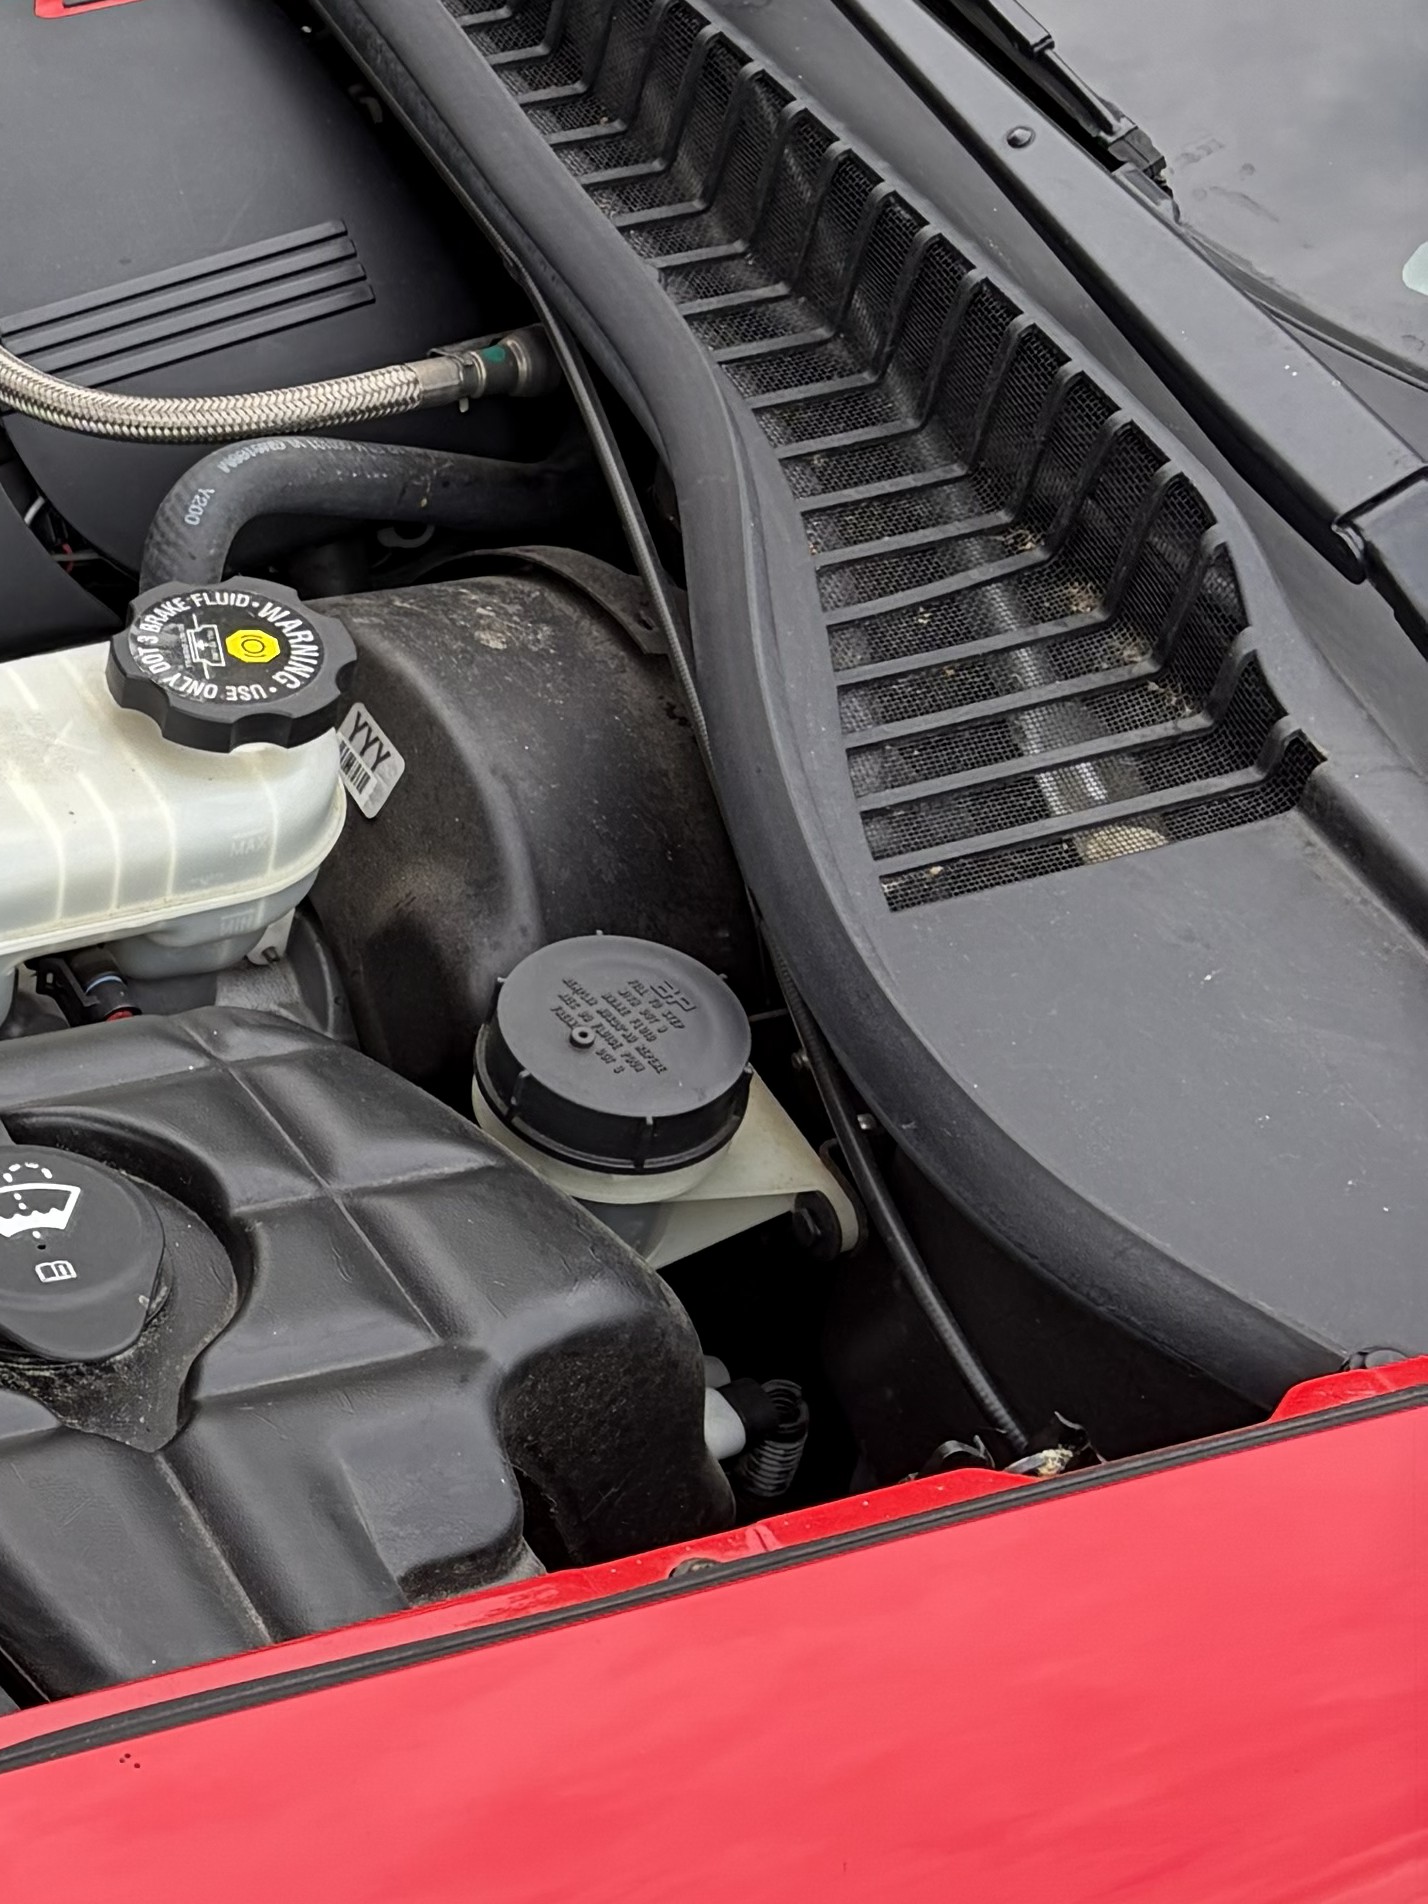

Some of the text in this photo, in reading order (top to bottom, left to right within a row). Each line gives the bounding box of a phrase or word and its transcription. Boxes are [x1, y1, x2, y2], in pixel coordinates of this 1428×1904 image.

[140, 597, 191, 632] BRAKE
[190, 592, 250, 607] FLUID
[138, 645, 172, 675] DOT
[257, 601, 320, 690] WARNING
[164, 673, 218, 700] ONLY
[225, 684, 267, 701] USE
[348, 710, 391, 771] YYY
